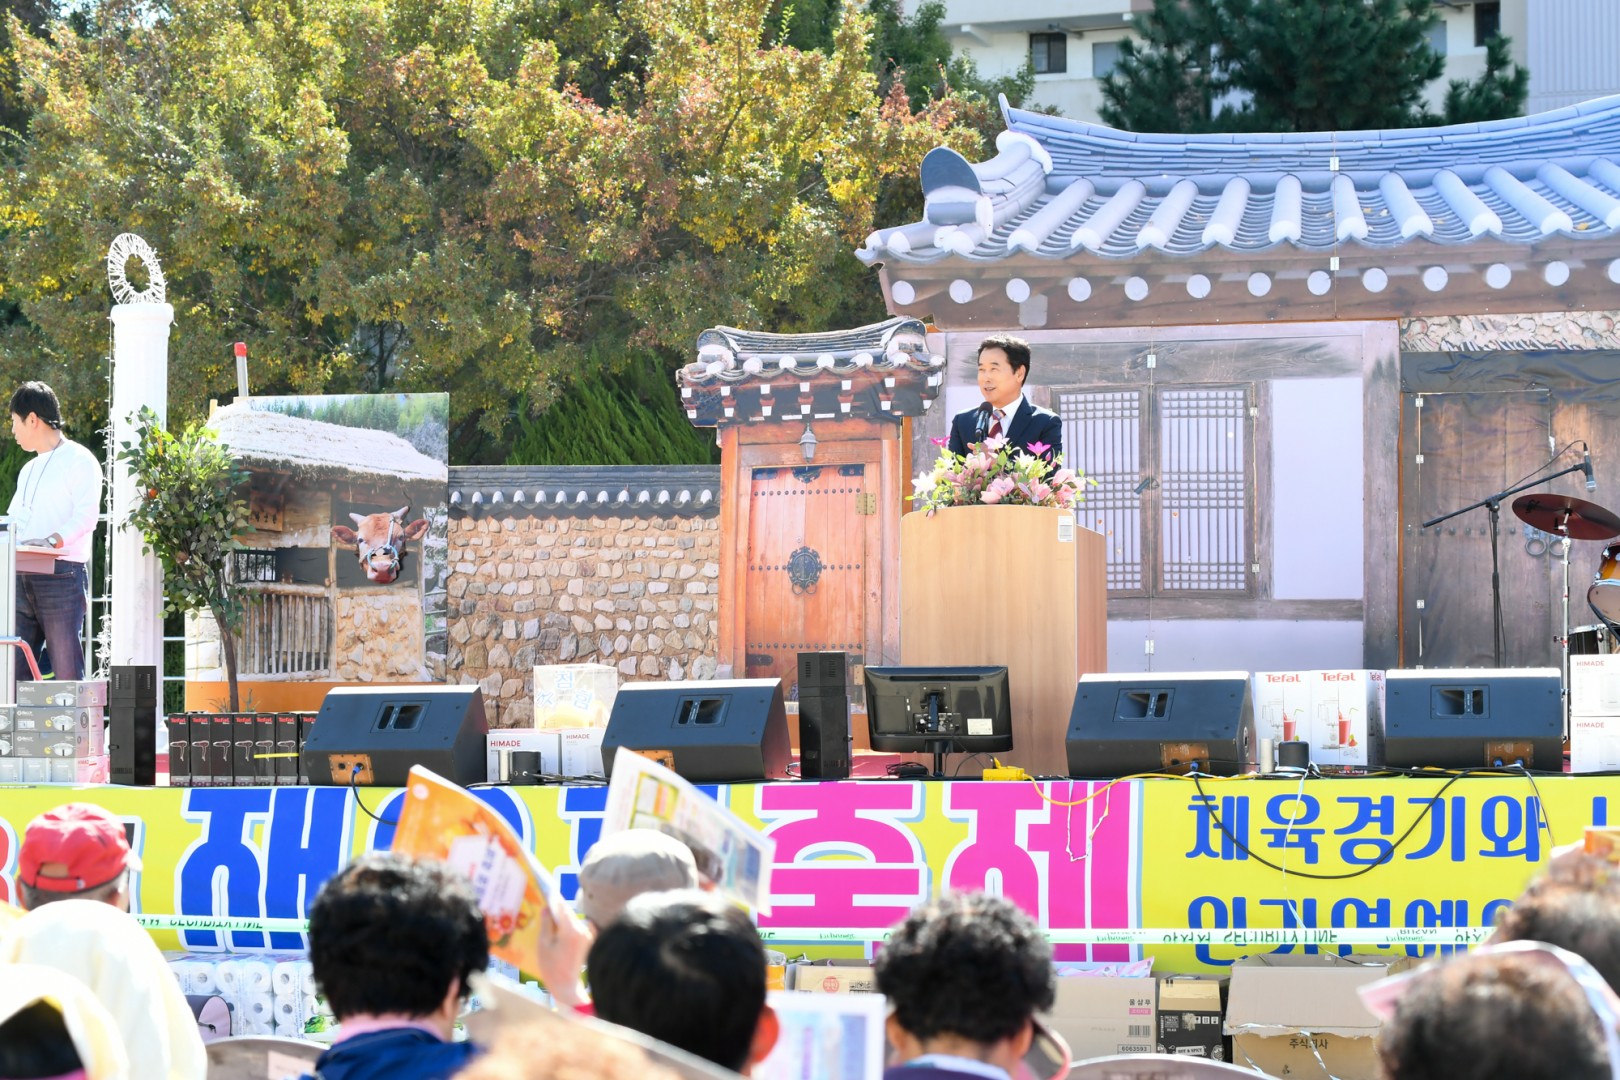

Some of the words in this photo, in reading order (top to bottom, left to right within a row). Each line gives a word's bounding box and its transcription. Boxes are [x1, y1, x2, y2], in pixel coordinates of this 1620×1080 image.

[1265, 673, 1302, 683] Tefal
[1321, 672, 1356, 682] Tefal
[1369, 672, 1382, 681] Tefal
[1186, 795, 1547, 865] 체육경기와
[1188, 895, 1513, 967] 인기연예
